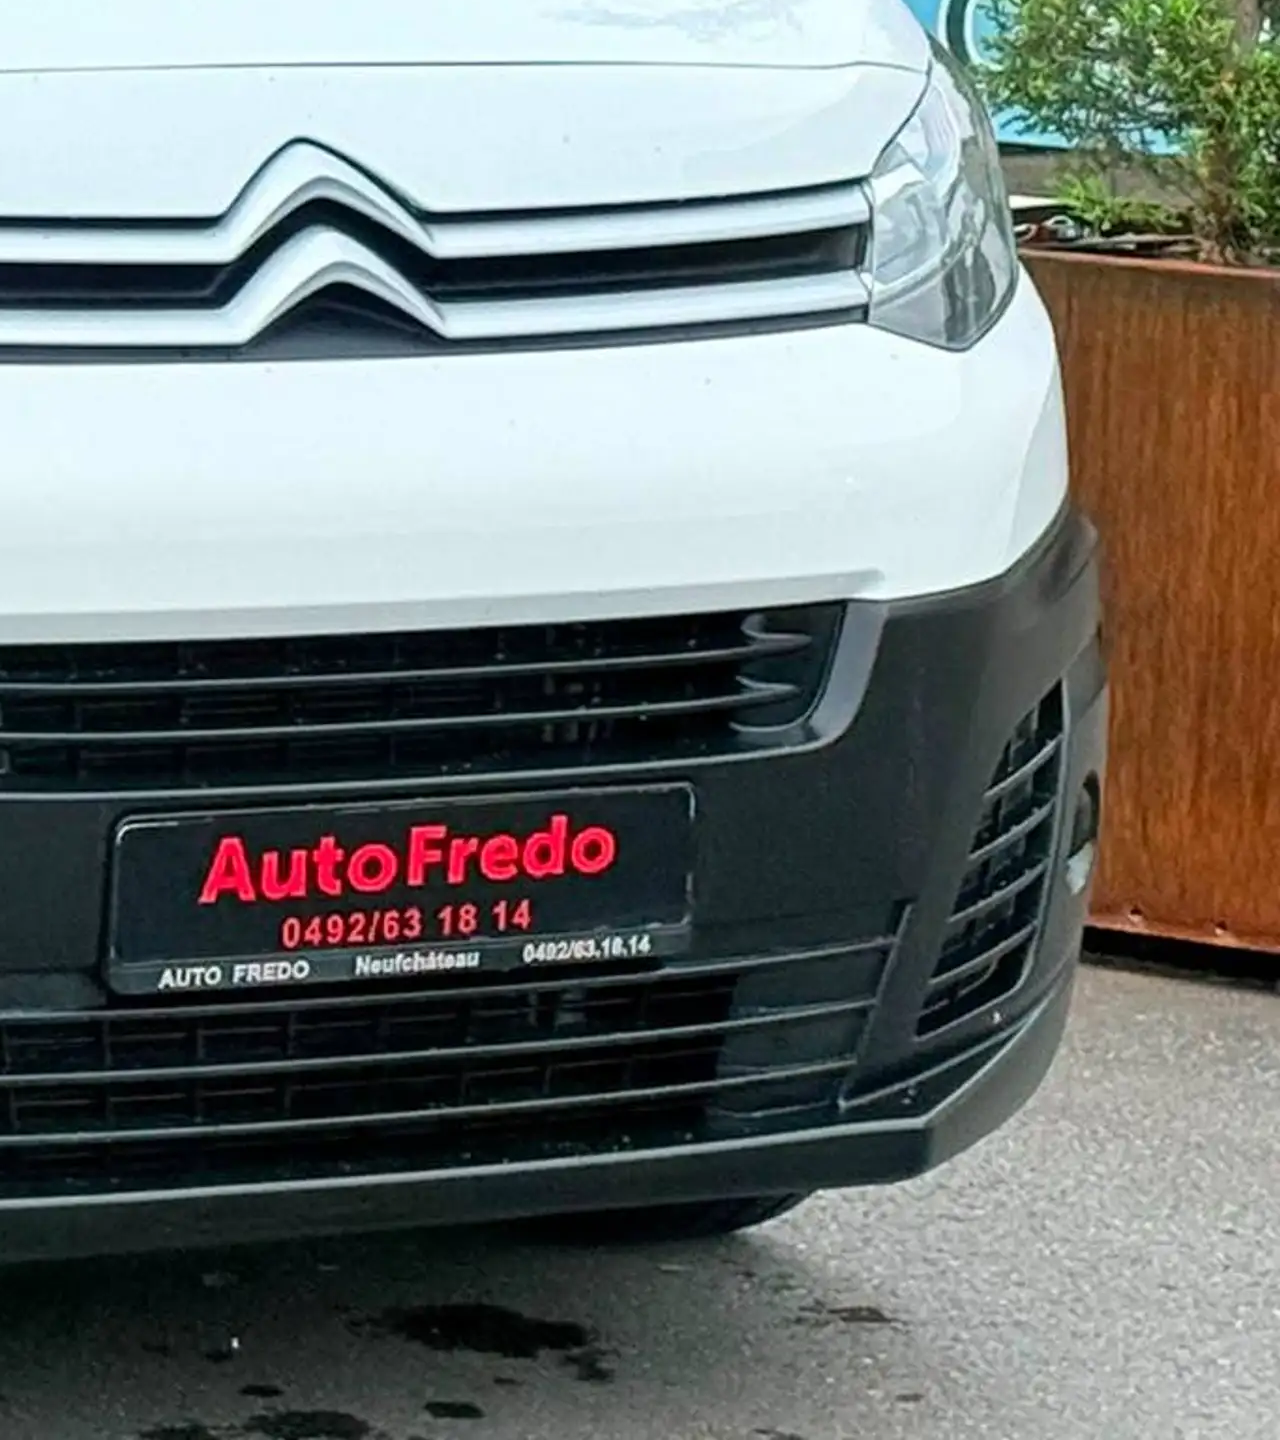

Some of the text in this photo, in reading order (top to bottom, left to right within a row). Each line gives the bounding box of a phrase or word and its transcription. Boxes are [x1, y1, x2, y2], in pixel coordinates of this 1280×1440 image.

[197, 814, 616, 905] AutoFredo
[281, 898, 533, 950] 0492/63 18 14
[157, 966, 222, 990] AUTO
[232, 960, 311, 985] FREDO
